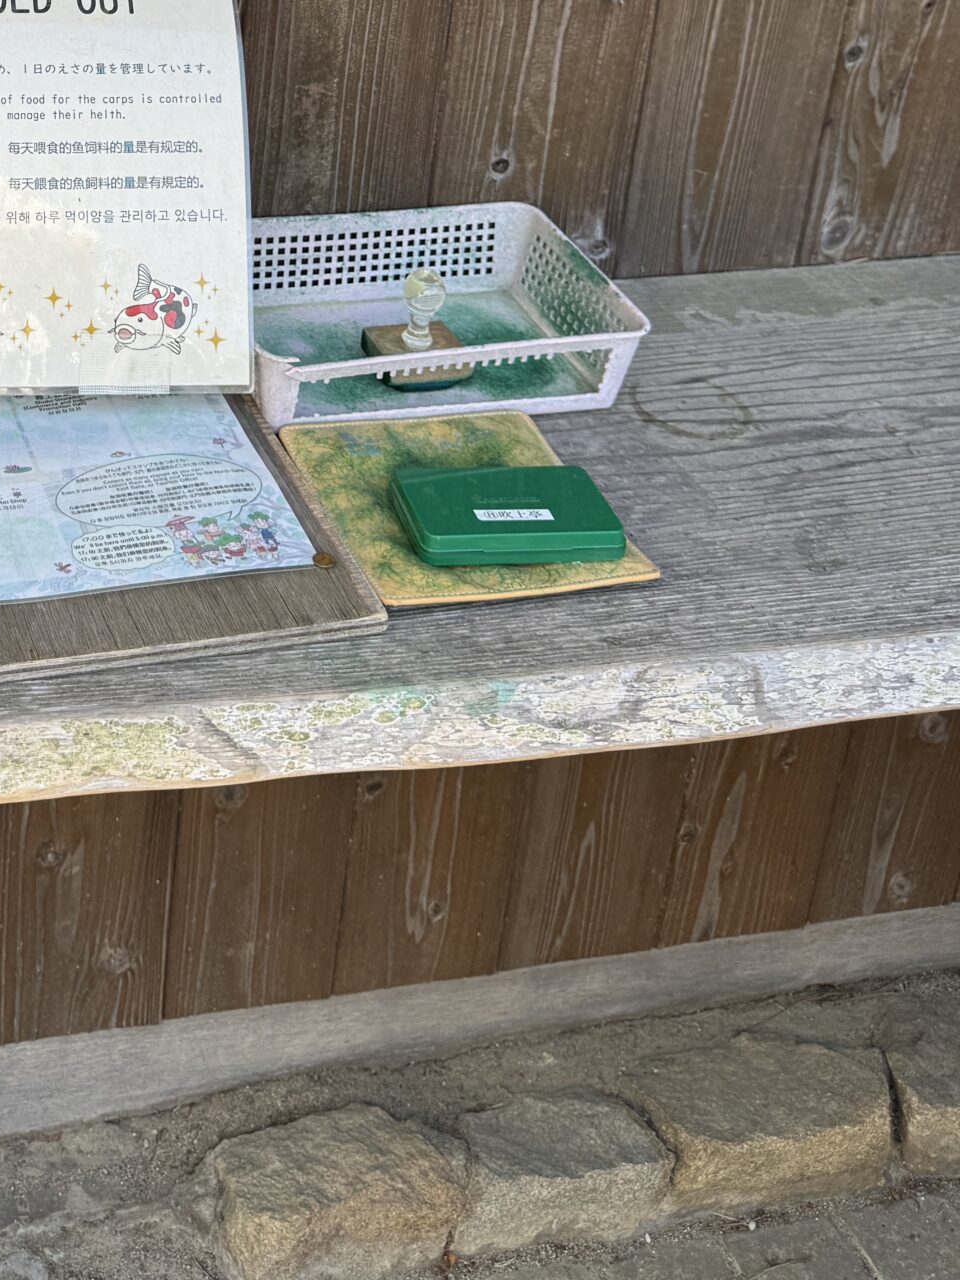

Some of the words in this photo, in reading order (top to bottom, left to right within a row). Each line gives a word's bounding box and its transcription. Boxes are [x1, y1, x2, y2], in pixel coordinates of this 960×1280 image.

[0, 94, 13, 105] of
[20, 94, 46, 105] food
[51, 93, 70, 105] for
[77, 93, 97, 105] the
[102, 95, 134, 107] carps
[141, 93, 153, 104] is
[158, 93, 223, 105] controlled
[7, 112, 46, 122] manage
[52, 109, 84, 120] their
[90, 109, 127, 121] helth.
[6, 211, 31, 225] 위해
[35, 211, 61, 225] 하루
[64, 210, 115, 225] 먹이양을
[119, 210, 170, 223] 관리하고
[174, 209, 228, 223] 있습니다.
